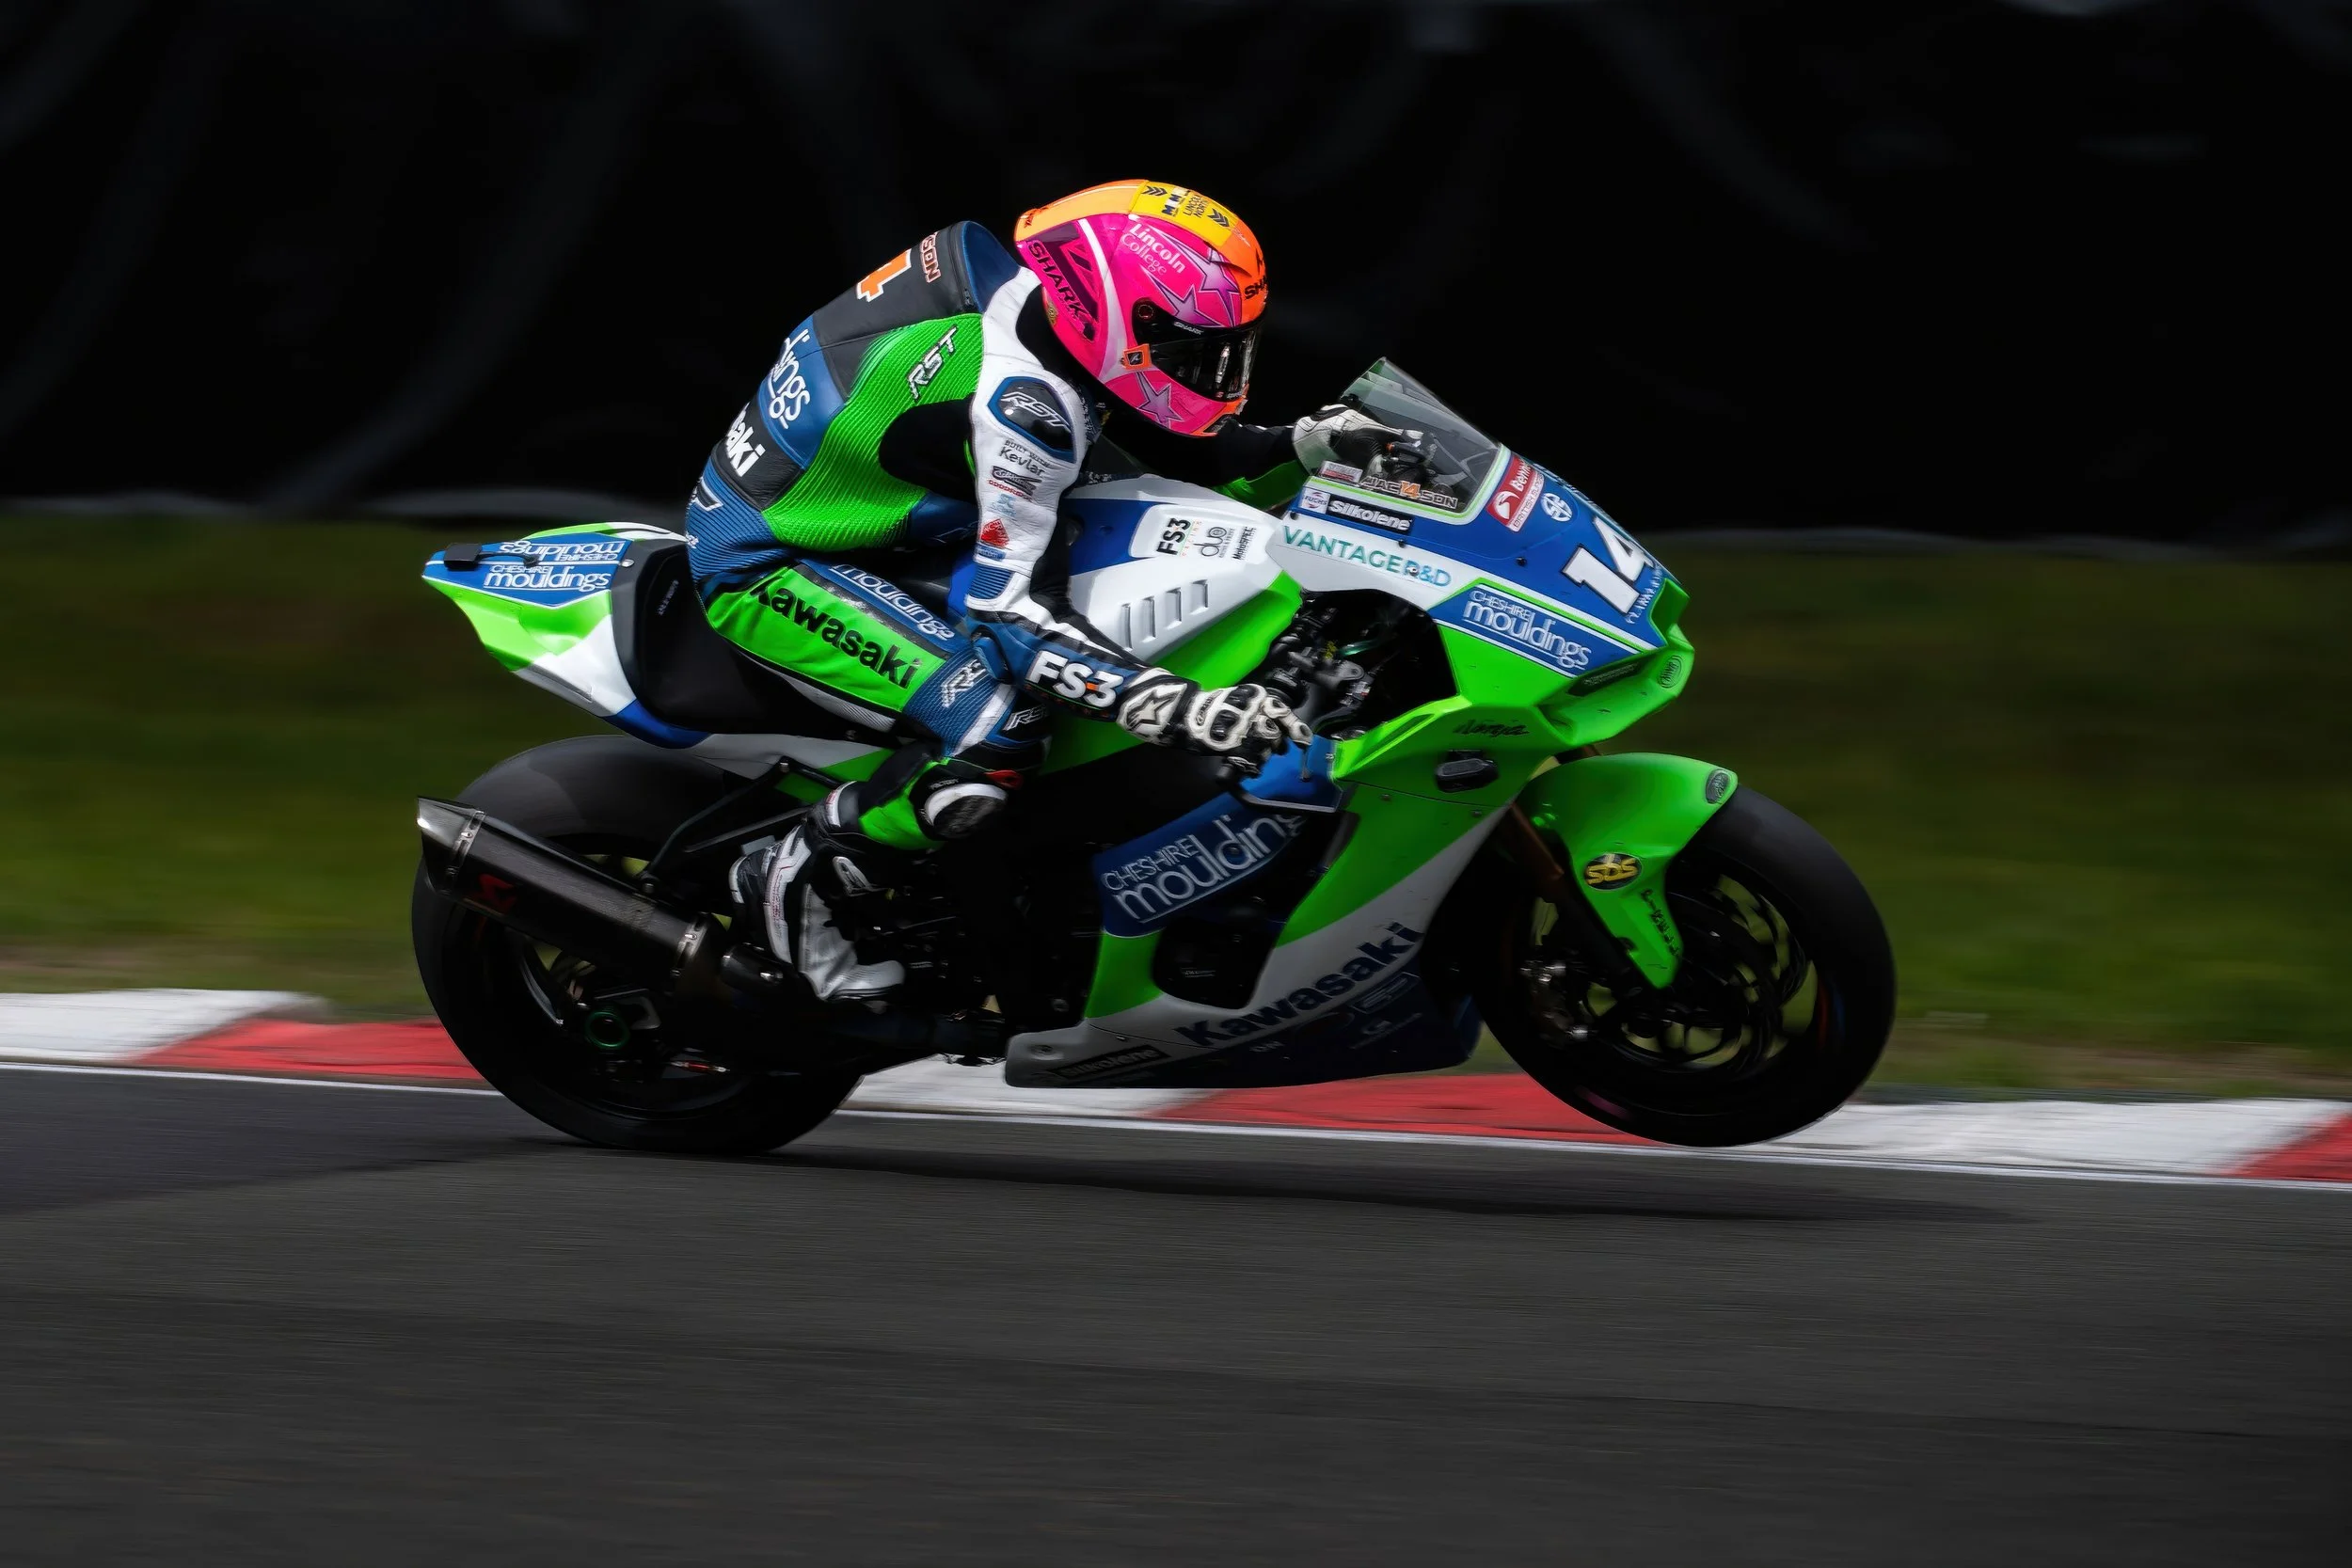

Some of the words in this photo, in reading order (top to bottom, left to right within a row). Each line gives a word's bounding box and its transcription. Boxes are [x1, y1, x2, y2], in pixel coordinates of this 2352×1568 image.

[919, 230, 941, 283] SON
[1120, 233, 1168, 276] College
[1130, 223, 1186, 274] Lincoln
[1027, 239, 1088, 325] SHARK
[907, 325, 958, 401] RST
[999, 391, 1073, 433] RST
[999, 446, 1046, 477] Kevlar
[1004, 437, 1027, 454] BUILT
[1304, 494, 1327, 506] FUCHS
[1328, 499, 1411, 531] Silkolene
[1513, 493, 1536, 528] BRITISH
[499, 540, 626, 562] mouldings
[1156, 518, 1191, 556] FS3
[1193, 526, 1227, 557] duo
[1281, 524, 1402, 573] VANTAGE
[484, 566, 612, 593] mouldings
[490, 564, 549, 575] CHESHIRE
[1561, 515, 1656, 616] 14
[1469, 589, 1532, 624] CHESHIRE
[1462, 600, 1592, 670] mouldings
[941, 659, 984, 708] RS
[1026, 650, 1124, 707] FS3
[1102, 833, 1200, 891] CHESHIRE
[1113, 815, 1306, 922] mouldin
[1174, 921, 1425, 1048] Kawasaki
